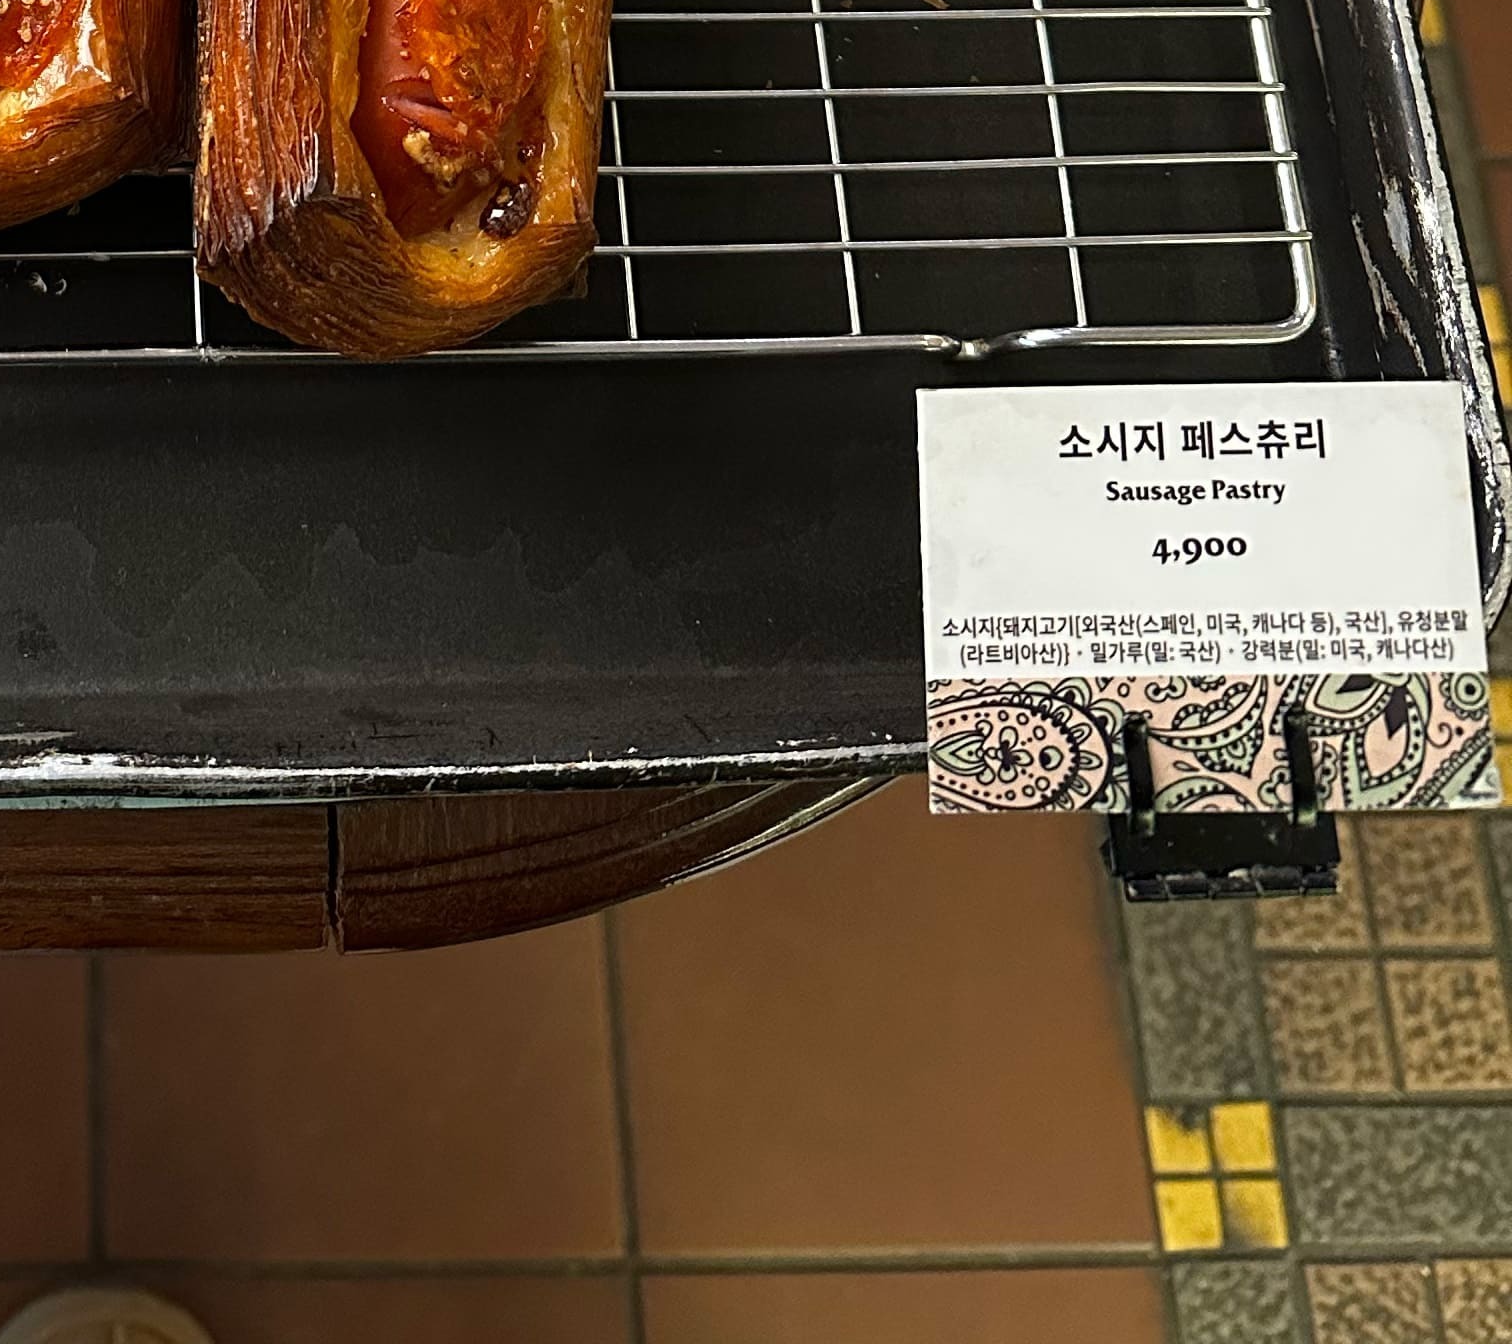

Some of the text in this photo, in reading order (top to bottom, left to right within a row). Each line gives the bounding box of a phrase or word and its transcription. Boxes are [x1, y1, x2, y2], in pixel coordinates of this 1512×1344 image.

[1058, 419, 1326, 461] 소시지 페스츄리
[1105, 479, 1286, 505] Sausage Pastry
[1151, 536, 1248, 565] 4,900
[1207, 613, 1247, 636] 미국,
[1253, 611, 1305, 635] 캐나다
[1310, 611, 1341, 636] 등),
[1344, 610, 1393, 634] 국산],
[1397, 609, 1468, 633] 유청분말
[1180, 640, 1221, 665] 국산)
[1331, 637, 1372, 662] 미국,
[1377, 636, 1454, 661] 캐나다산)
